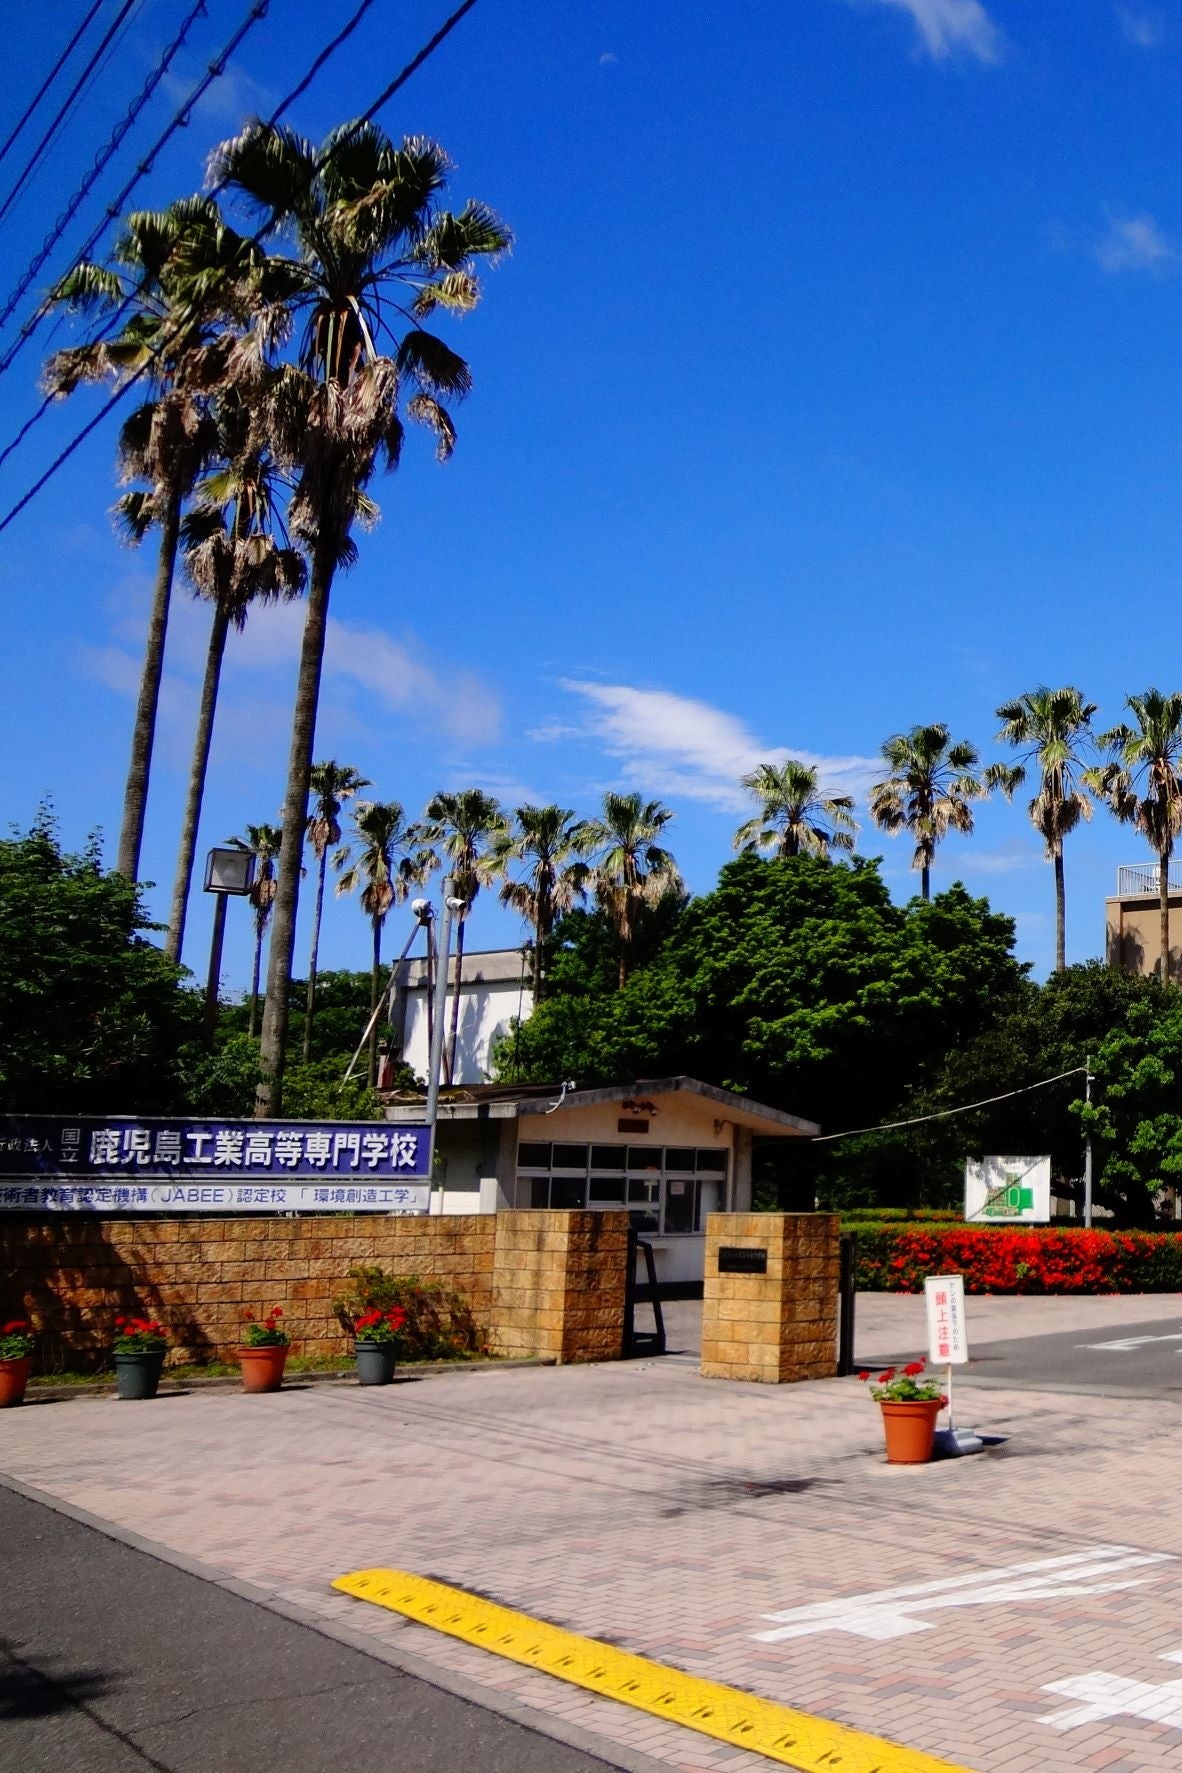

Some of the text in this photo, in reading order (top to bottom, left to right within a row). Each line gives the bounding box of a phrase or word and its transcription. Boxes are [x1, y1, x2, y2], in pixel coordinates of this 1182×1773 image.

[89, 1128, 417, 1168] 鹿児島工業高等専門学校
[935, 1291, 951, 1358] 頭上注意
